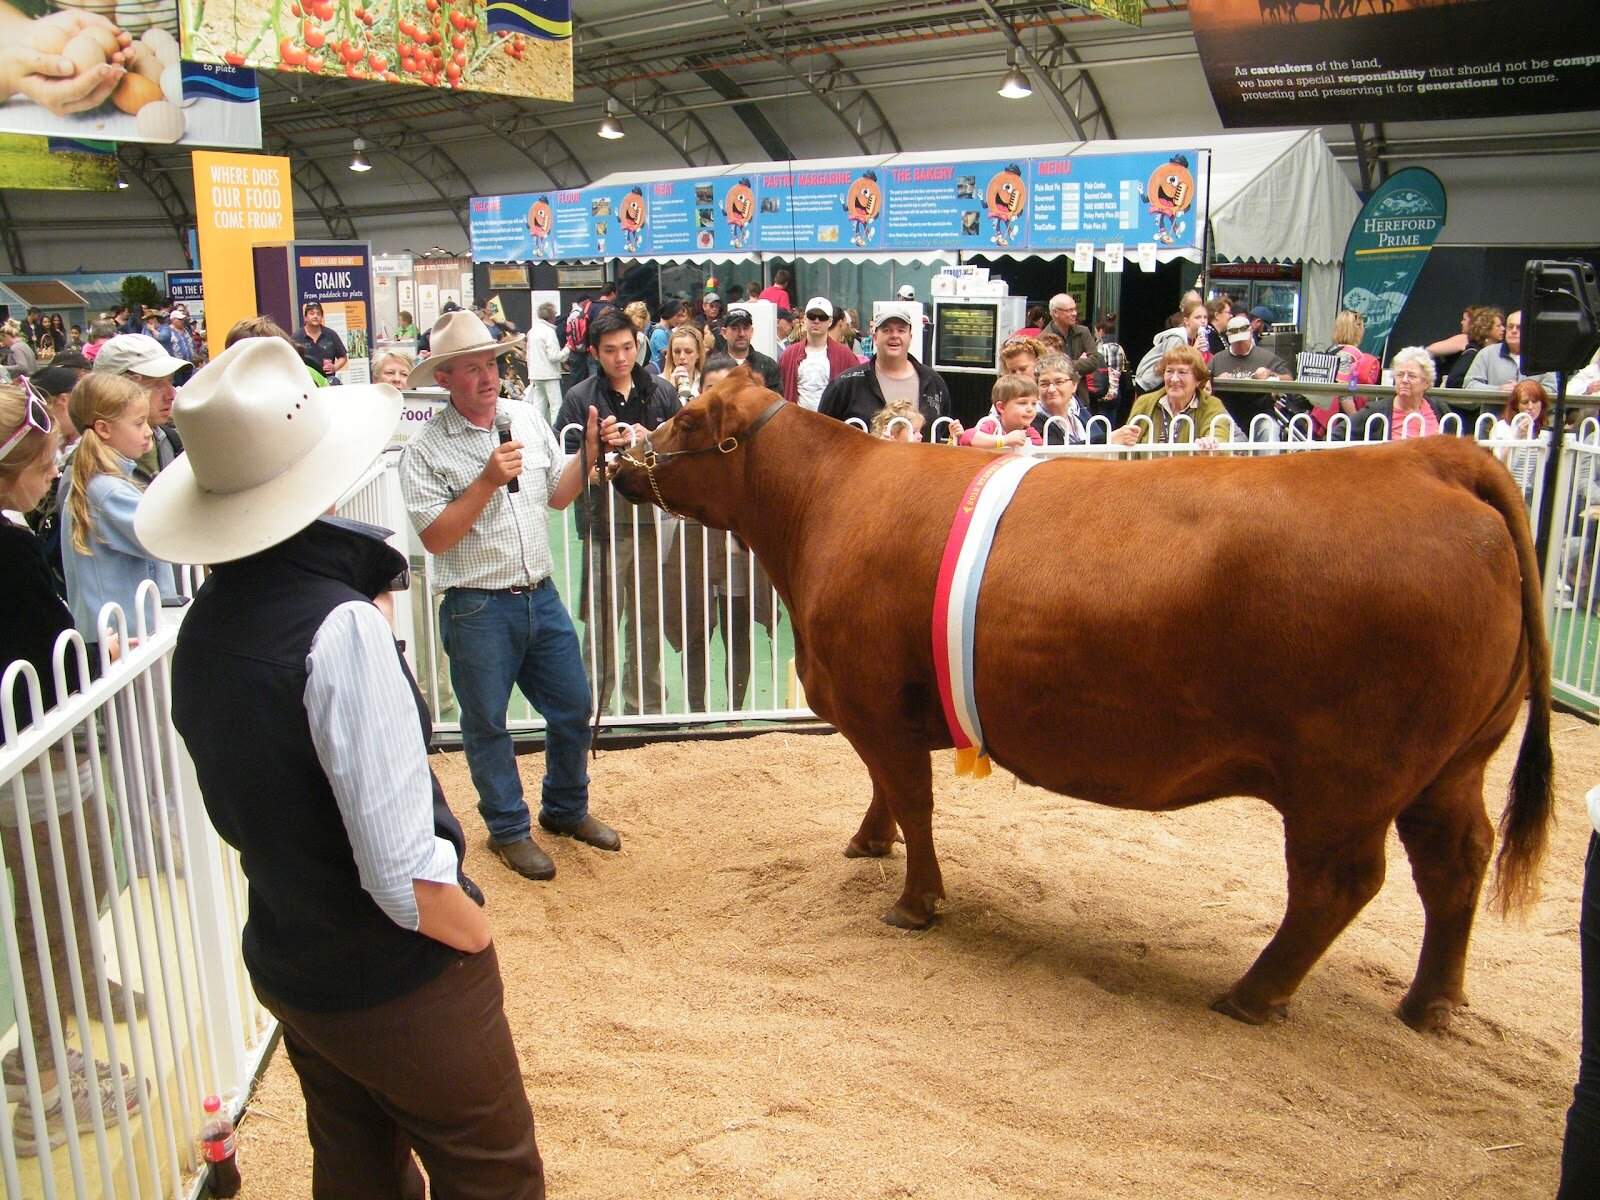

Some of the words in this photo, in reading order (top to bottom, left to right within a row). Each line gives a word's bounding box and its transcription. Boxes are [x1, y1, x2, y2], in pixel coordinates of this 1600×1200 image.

[203, 63, 212, 71] to
[215, 65, 236, 74] plate
[1235, 66, 1248, 76] As
[1250, 63, 1313, 75] caretakers
[1316, 61, 1327, 71] of
[1329, 60, 1348, 70] the
[1351, 58, 1382, 69] land,
[1237, 80, 1254, 88] we
[1257, 77, 1284, 87] have
[1296, 74, 1336, 87] special
[1338, 70, 1426, 84] responsibility
[1429, 68, 1454, 78] that
[1458, 63, 1500, 76] should
[1505, 60, 1527, 72] not
[1531, 58, 1549, 70] be
[1242, 90, 1295, 101] protecting
[1298, 88, 1319, 98] and
[1322, 85, 1383, 98] preserving
[1385, 84, 1394, 94] it
[1398, 83, 1413, 92] for
[1417, 79, 1498, 93] generations
[1502, 75, 1514, 86] to
[1518, 73, 1559, 84] come.
[892, 169, 912, 183] THE
[914, 167, 954, 182] BAKERY
[1038, 160, 1072, 176] MENU
[210, 166, 248, 185] WHERE
[252, 168, 280, 187] DOES
[762, 175, 795, 188] PASTRY
[798, 171, 851, 186] MARGARINE
[212, 186, 241, 208] OUR
[246, 188, 281, 209] FOOD
[558, 192, 581, 204] FLOUR
[214, 210, 244, 228] COME
[248, 211, 282, 228] FROM?
[1364, 219, 1436, 233] HEREFORD
[1378, 233, 1420, 247] PRIME
[1220, 266, 1242, 274] enjoy
[314, 272, 351, 289] GRAINS
[172, 286, 183, 295] ON
[184, 285, 198, 294] THE
[319, 291, 341, 300] paddock
[350, 290, 363, 299] plate
[1304, 367, 1328, 375] MORISH
